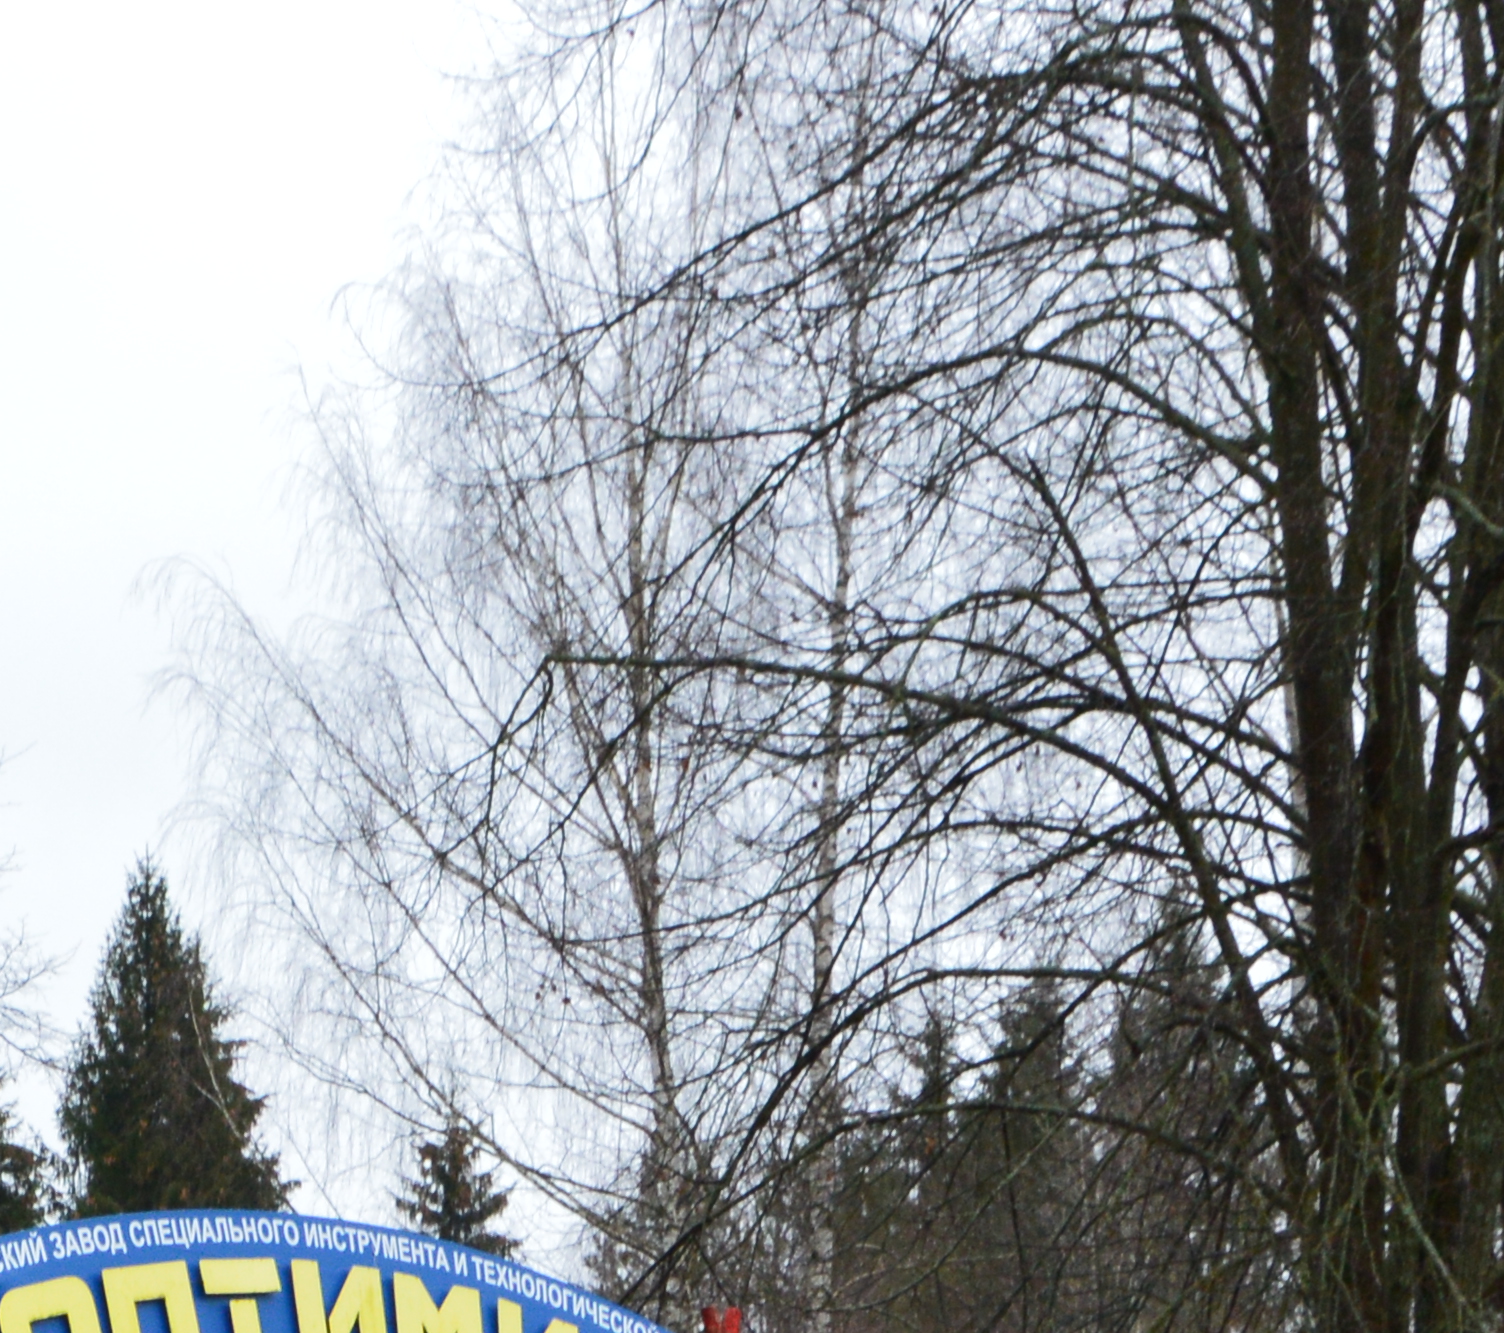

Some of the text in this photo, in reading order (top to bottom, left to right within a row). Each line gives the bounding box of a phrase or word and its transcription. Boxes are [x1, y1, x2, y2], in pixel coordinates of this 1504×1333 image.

[53, 1222, 128, 1261] ЗАВОД
[131, 1216, 300, 1251] СПЕЦИАЛЬНОГО
[304, 1222, 449, 1273] ИНСТРУМЕНТА
[453, 1250, 469, 1277] И
